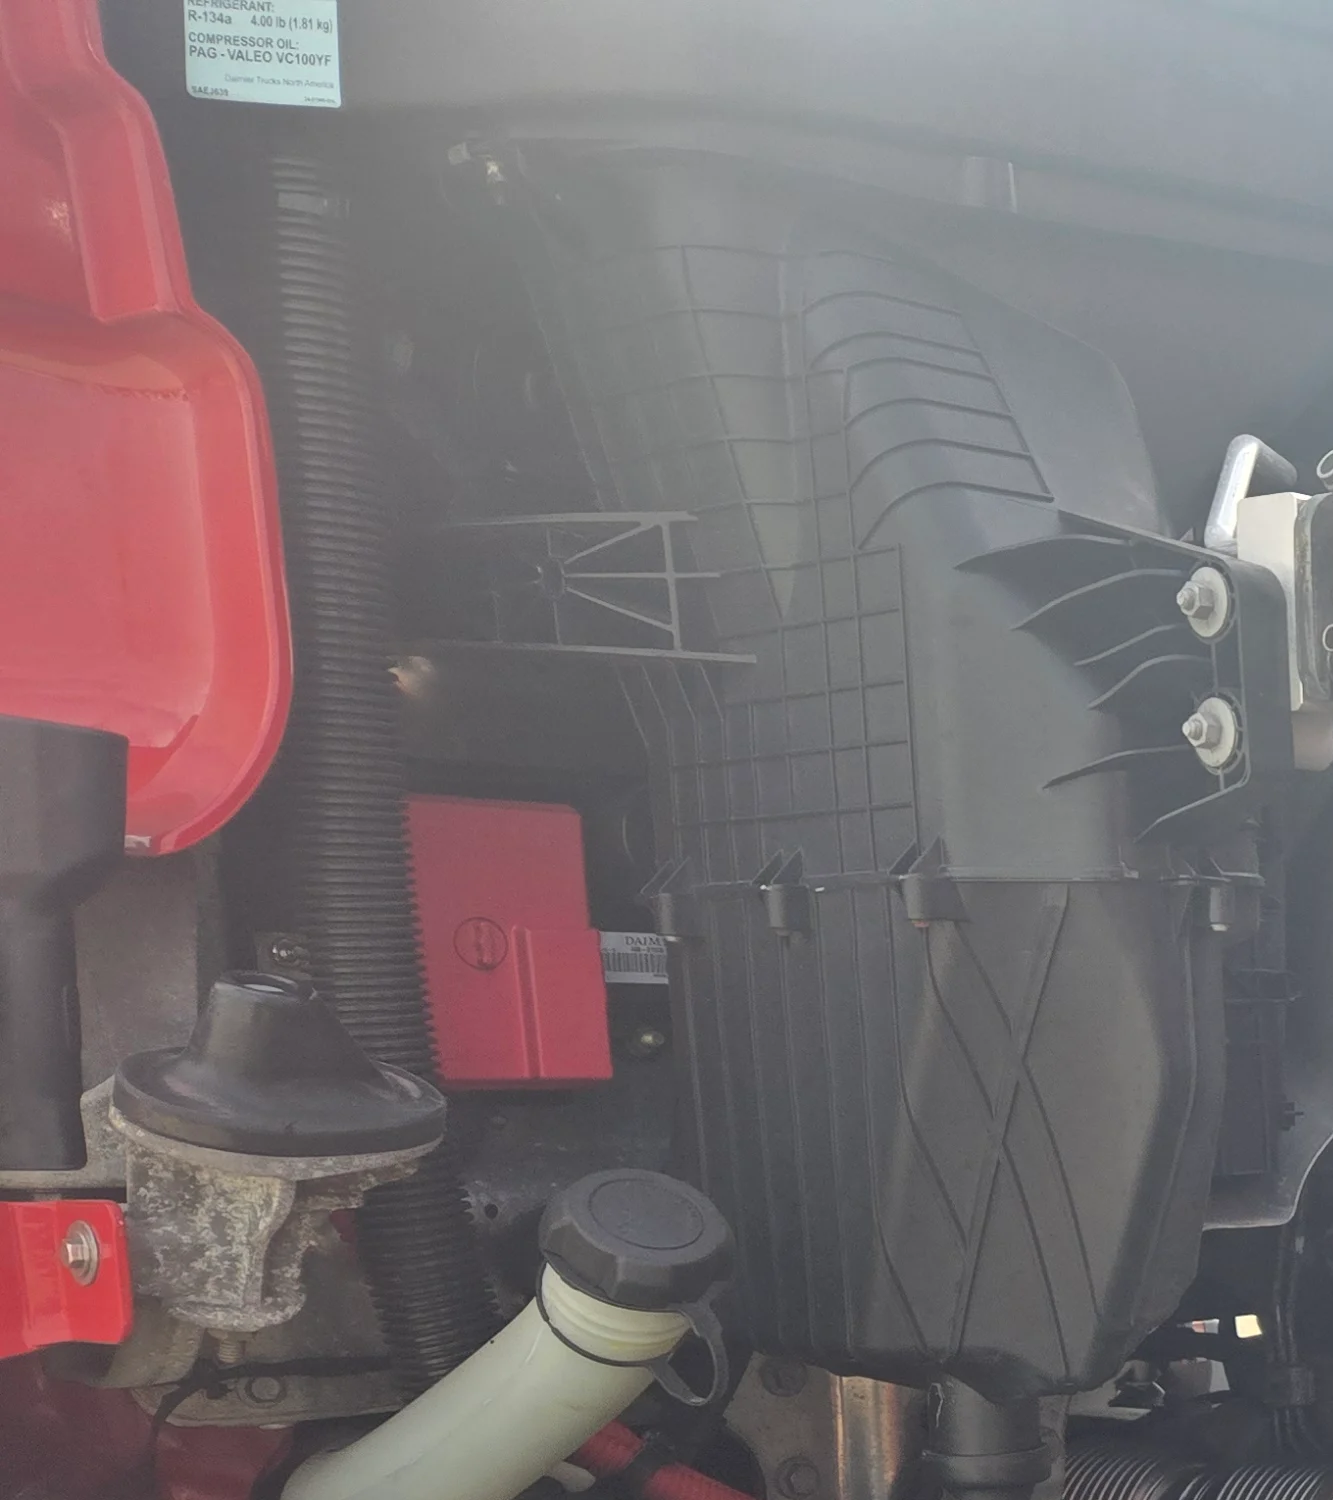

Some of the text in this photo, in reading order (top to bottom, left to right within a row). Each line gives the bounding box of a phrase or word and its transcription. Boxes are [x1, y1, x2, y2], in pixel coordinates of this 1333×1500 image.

[187, 0, 275, 13] REFRIGERANT:
[188, 10, 333, 34] R-134a 4.00 lb (1.81 kg)
[188, 32, 299, 50] COMPRESSOR OIL:
[189, 45, 217, 59] PAG
[227, 48, 273, 63] VALEO
[276, 51, 332, 66] VC100YF
[624, 935, 662, 946] DAIM
